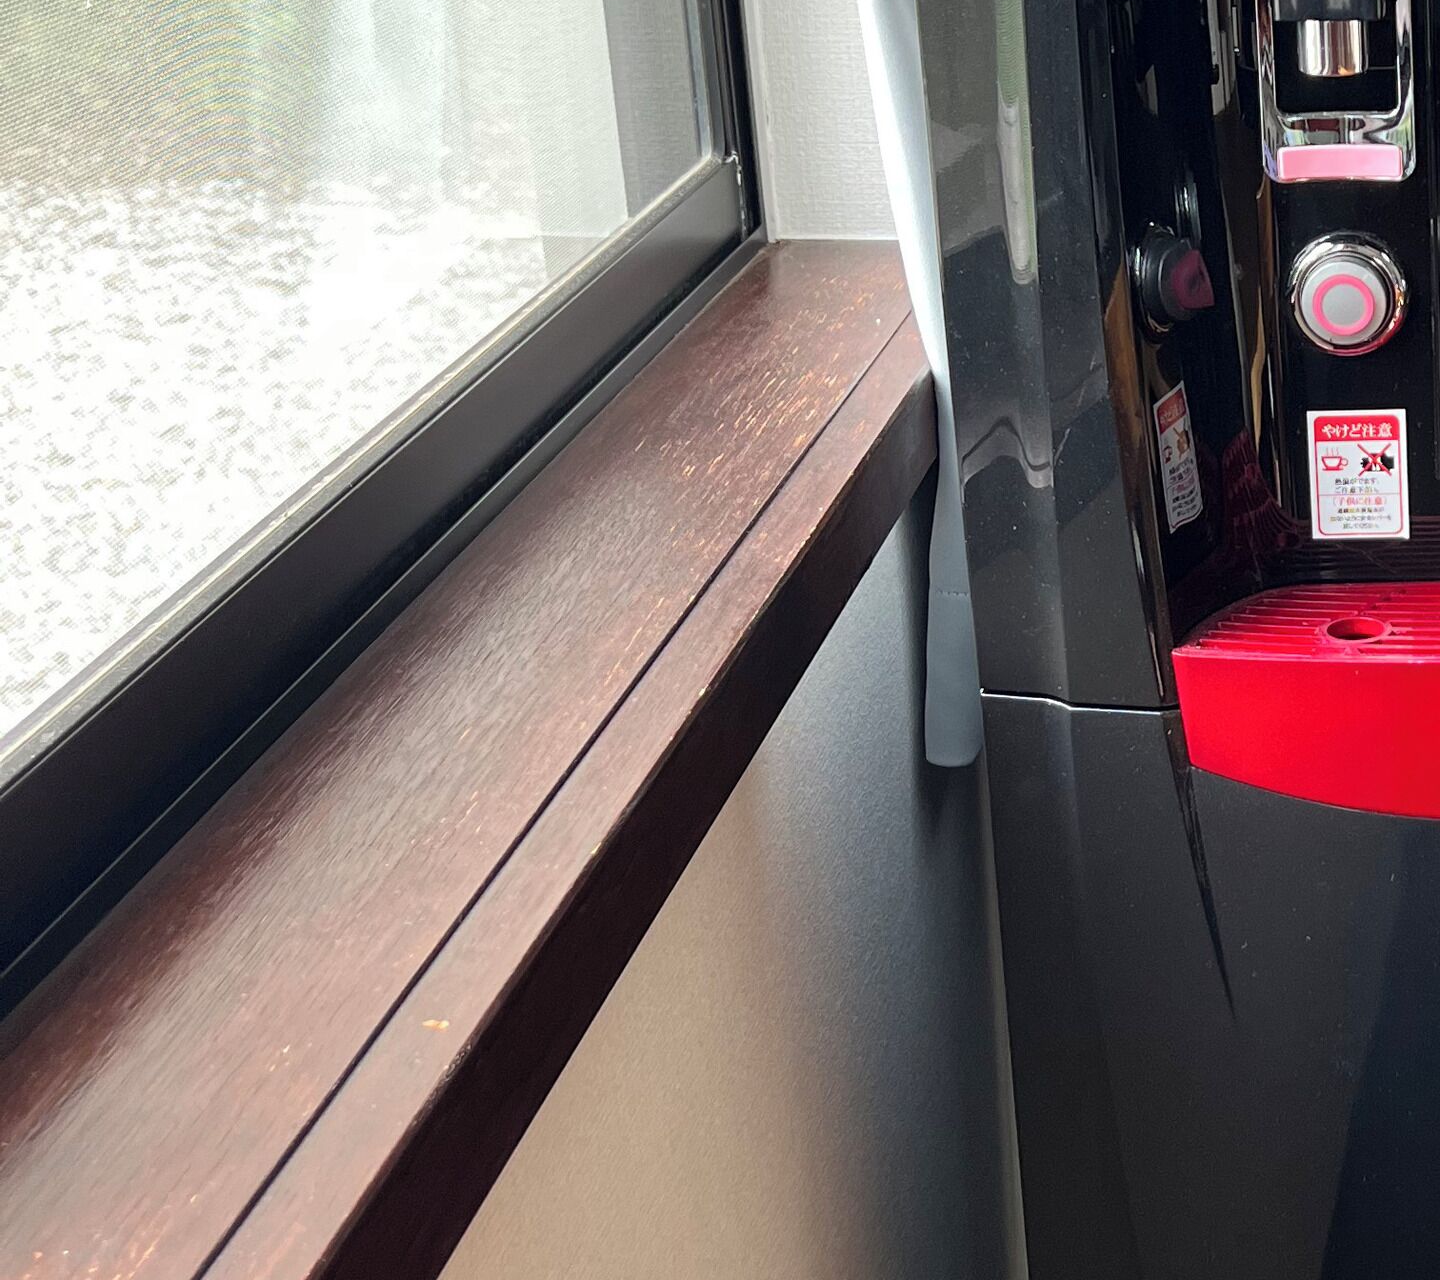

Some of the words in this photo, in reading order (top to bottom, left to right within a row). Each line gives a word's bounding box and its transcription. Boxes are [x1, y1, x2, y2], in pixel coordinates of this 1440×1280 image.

[1321, 422, 1393, 439] やけど注意
